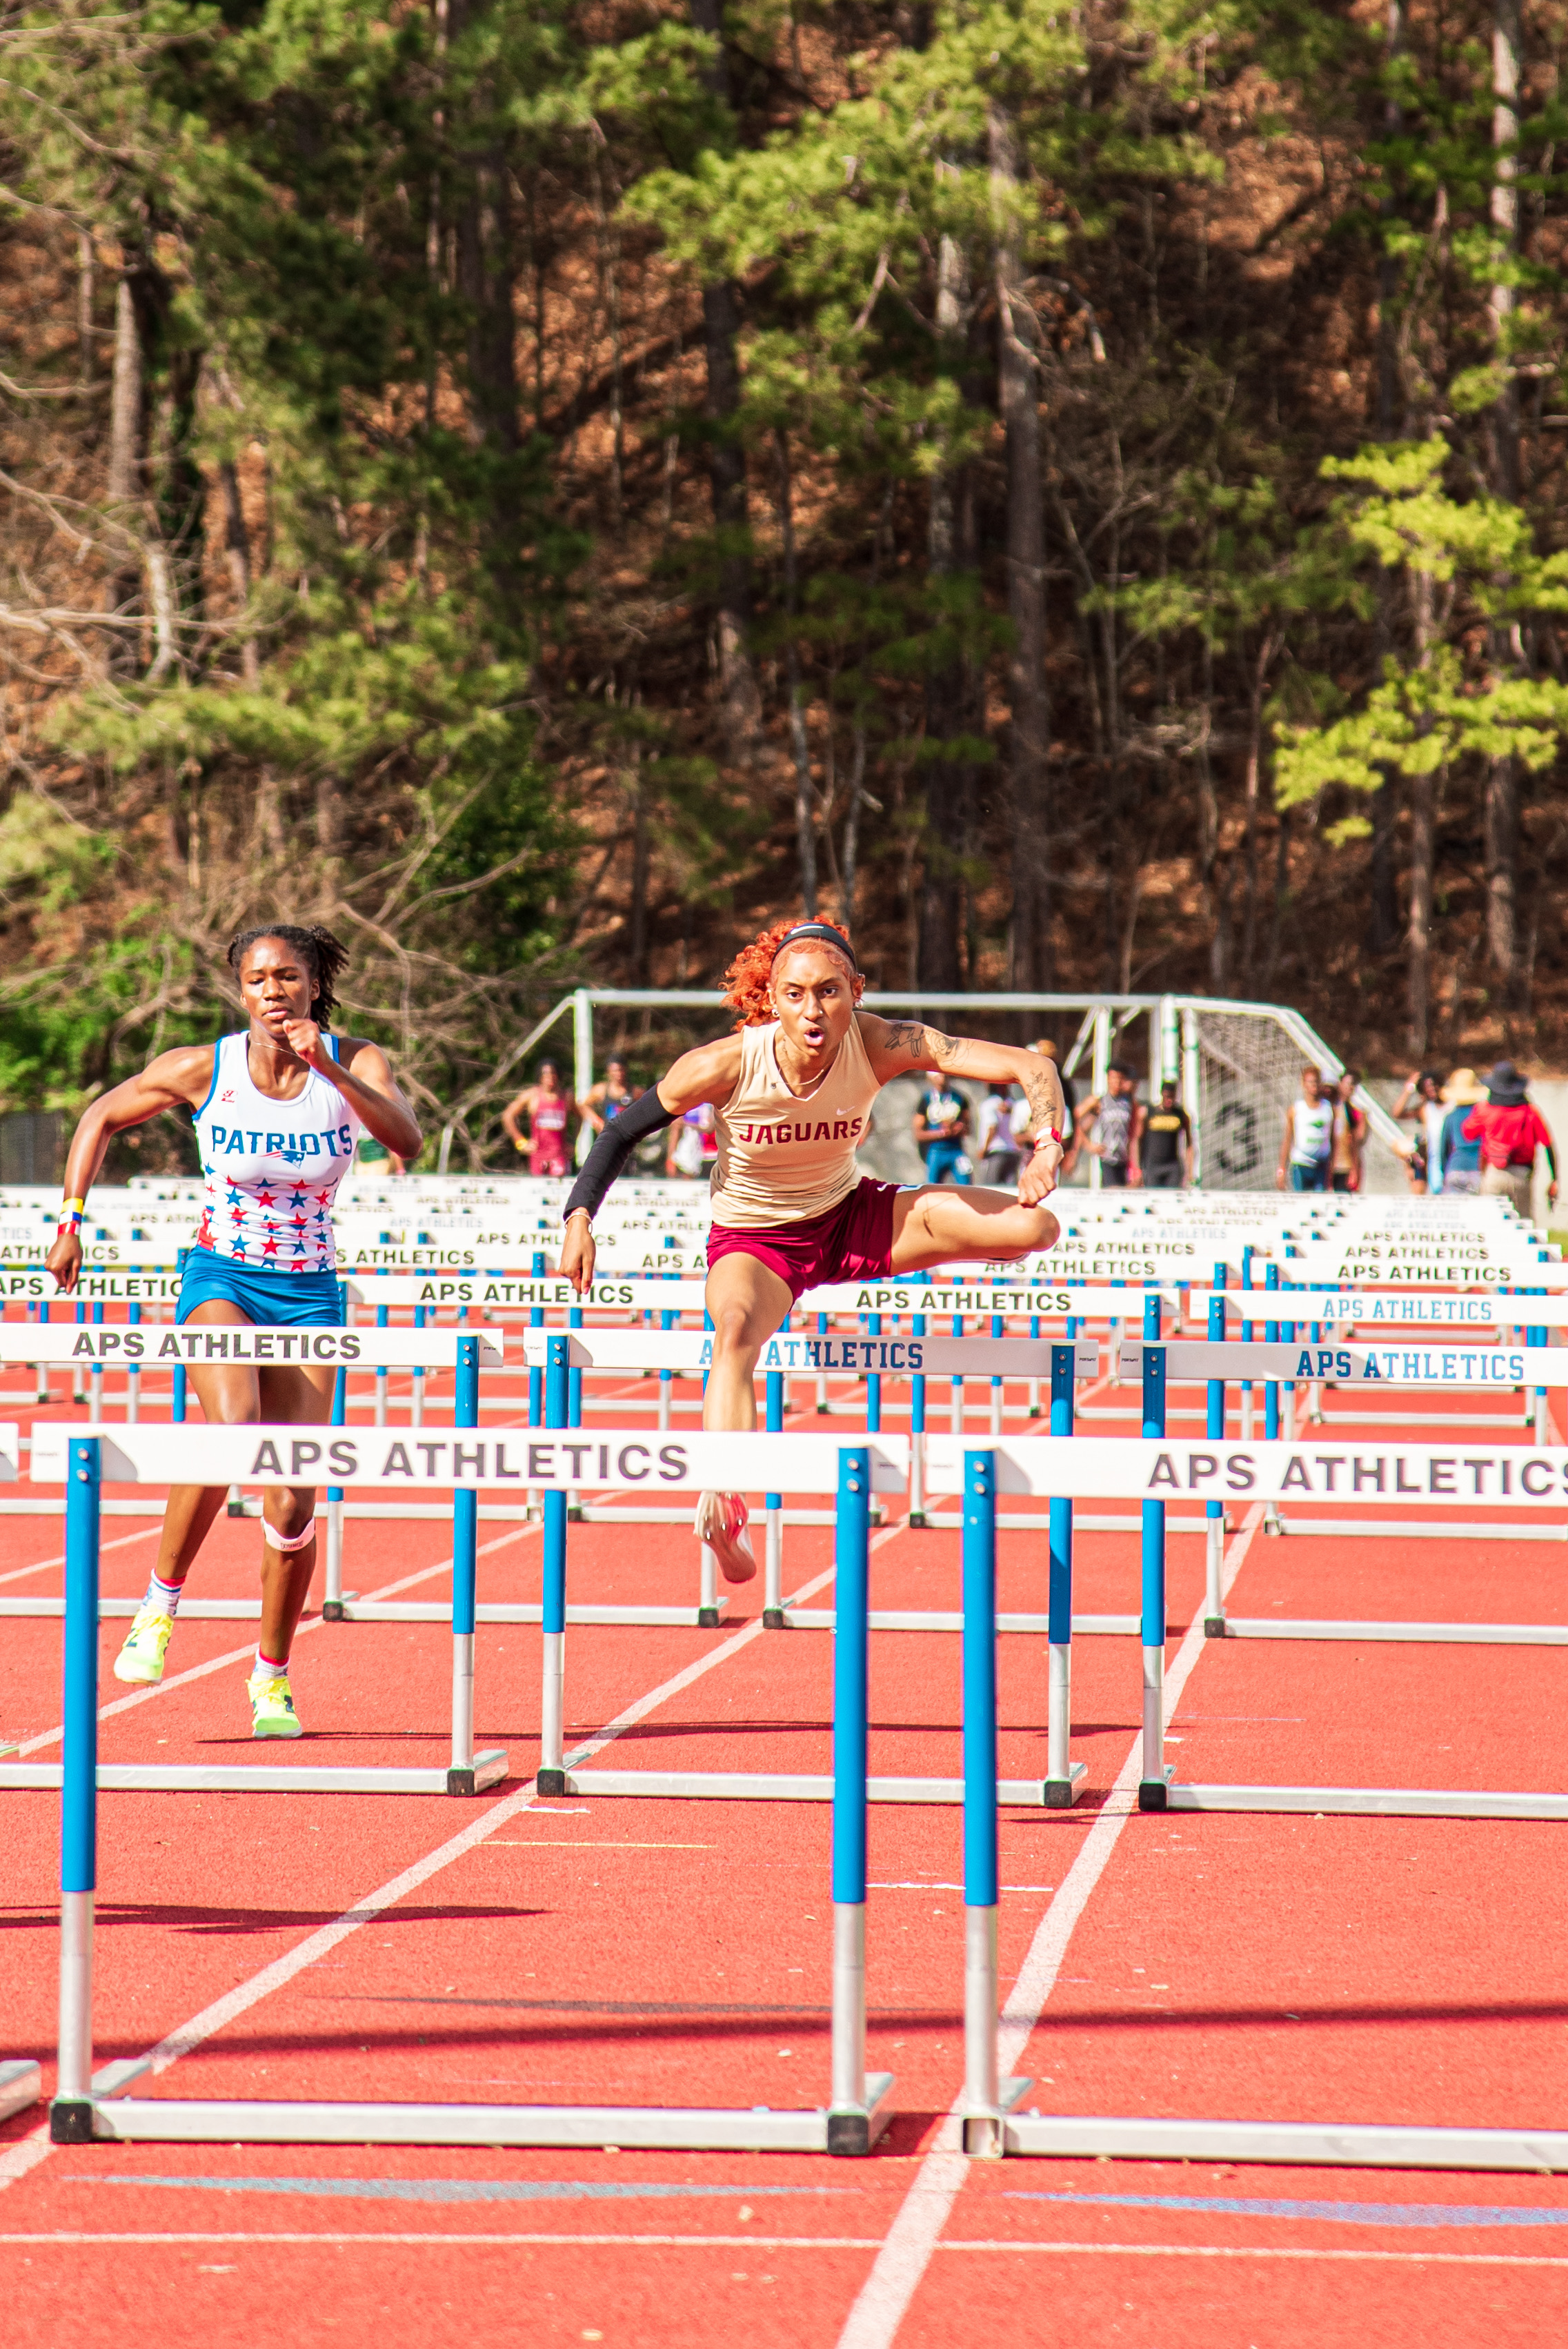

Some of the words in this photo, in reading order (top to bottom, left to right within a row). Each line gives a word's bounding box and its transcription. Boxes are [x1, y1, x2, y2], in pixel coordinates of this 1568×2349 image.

[739, 1117, 862, 1144] JAGUARS
[211, 1124, 353, 1157] PATRIOTS
[130, 1214, 159, 1223] APS
[1211, 1207, 1279, 1216] ATHLETICS
[390, 1216, 412, 1227] APS
[417, 1216, 484, 1227] ATHLETICS
[622, 1220, 650, 1230] APS
[657, 1220, 711, 1231] ATHLE
[476, 1232, 510, 1245] APS
[517, 1233, 617, 1246] ATHLCS
[1131, 1227, 1154, 1238] APS
[1159, 1227, 1227, 1239] ATHLETICS
[1362, 1231, 1393, 1242] APS
[1398, 1231, 1485, 1242] ATHLETICS
[1, 1245, 120, 1260] ATHICS
[355, 1248, 475, 1265] ATHLETICS
[1052, 1241, 1088, 1253] APS
[1094, 1242, 1195, 1255] ATHLETICS
[1344, 1245, 1380, 1258] APS
[1387, 1246, 1489, 1260] ATHLETICS
[642, 1253, 684, 1269] APS
[1035, 1259, 1156, 1276] ATHLETICS
[1337, 1264, 1381, 1279] APS
[1388, 1265, 1511, 1282] ATHLETICS
[419, 1282, 474, 1301] APS
[856, 1289, 910, 1309] APS
[920, 1290, 1072, 1311] ATHLETICS
[1322, 1298, 1364, 1318] APS
[1372, 1299, 1492, 1320] ATHLETICS
[72, 1331, 145, 1358] APS
[157, 1333, 361, 1360] ATHLETICS
[765, 1340, 924, 1369] ATHLETICS
[1296, 1350, 1352, 1378] APS
[1363, 1352, 1525, 1380] ATHLETICS
[250, 1440, 359, 1476] APS
[381, 1442, 688, 1481] ATHLETICS
[1148, 1453, 1257, 1491] APS
[1280, 1454, 1568, 1496] ATHLETIC
